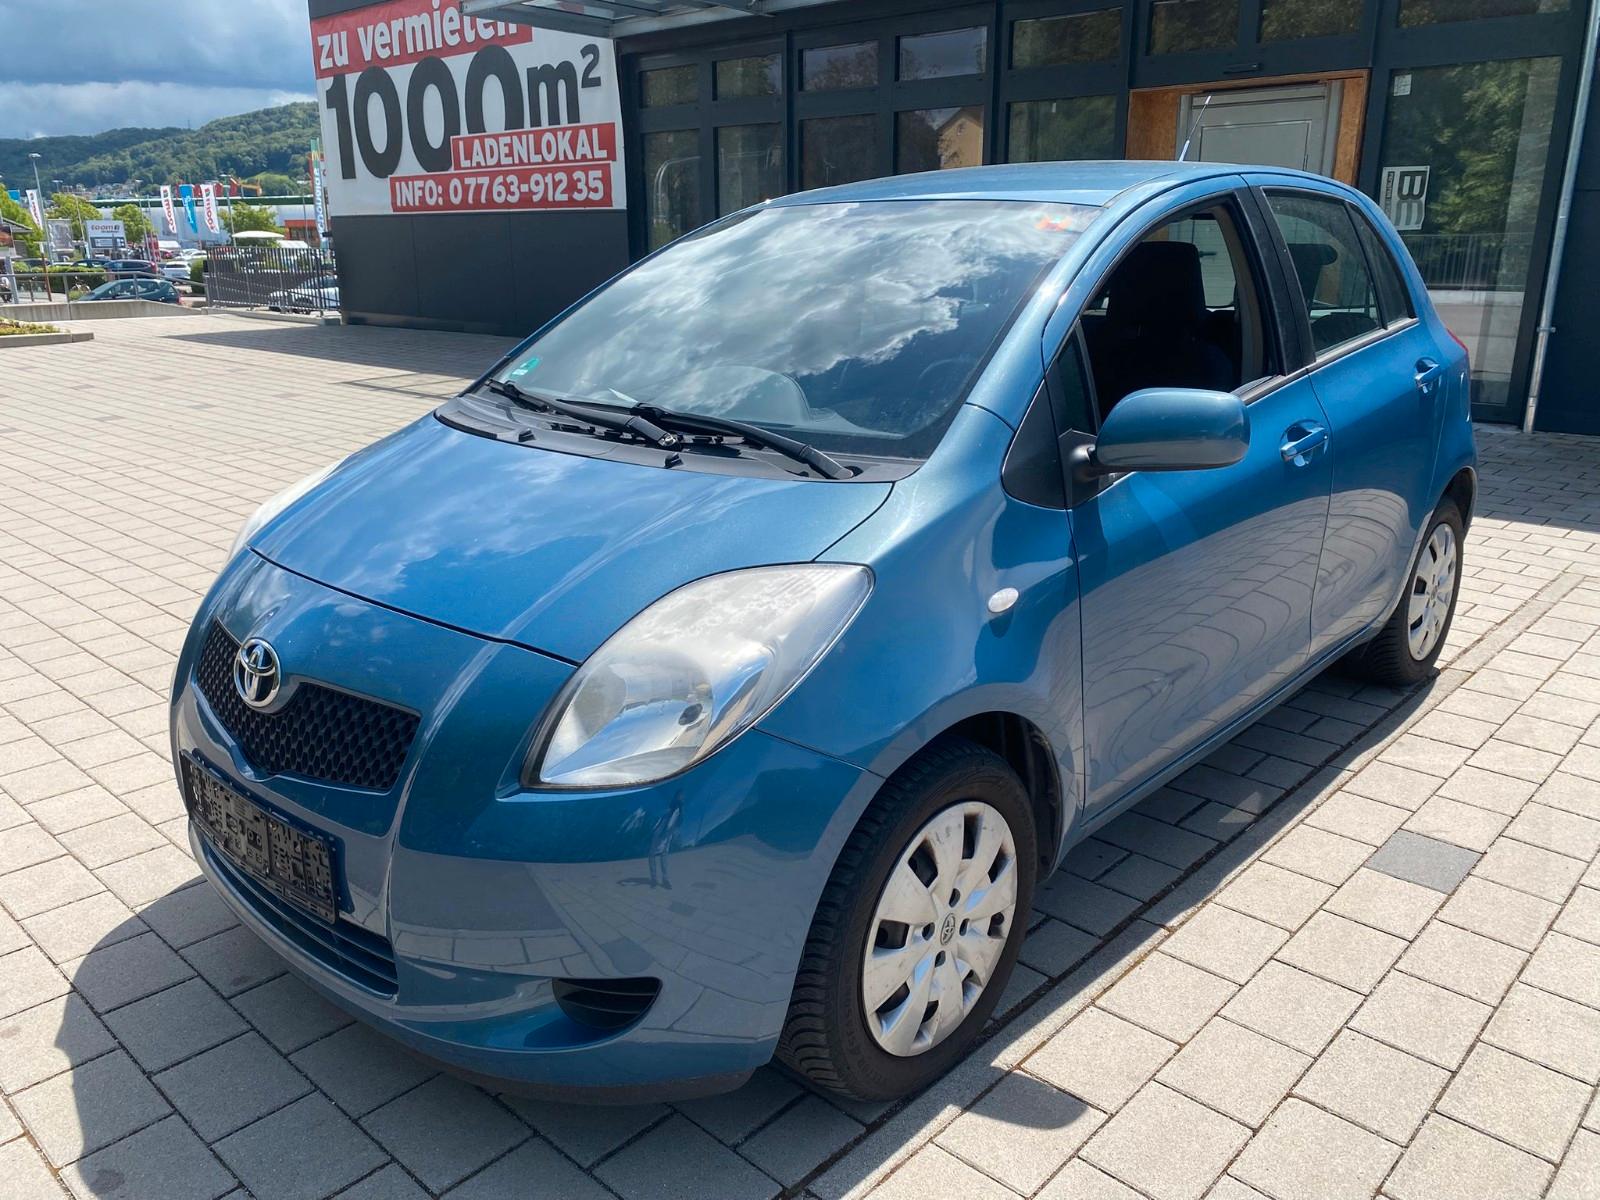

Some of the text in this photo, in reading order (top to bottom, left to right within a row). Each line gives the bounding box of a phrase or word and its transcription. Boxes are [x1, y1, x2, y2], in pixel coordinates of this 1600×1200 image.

[317, 31, 349, 69] zu
[458, 128, 607, 168] LADENLOKAL
[395, 179, 443, 207] INFO:
